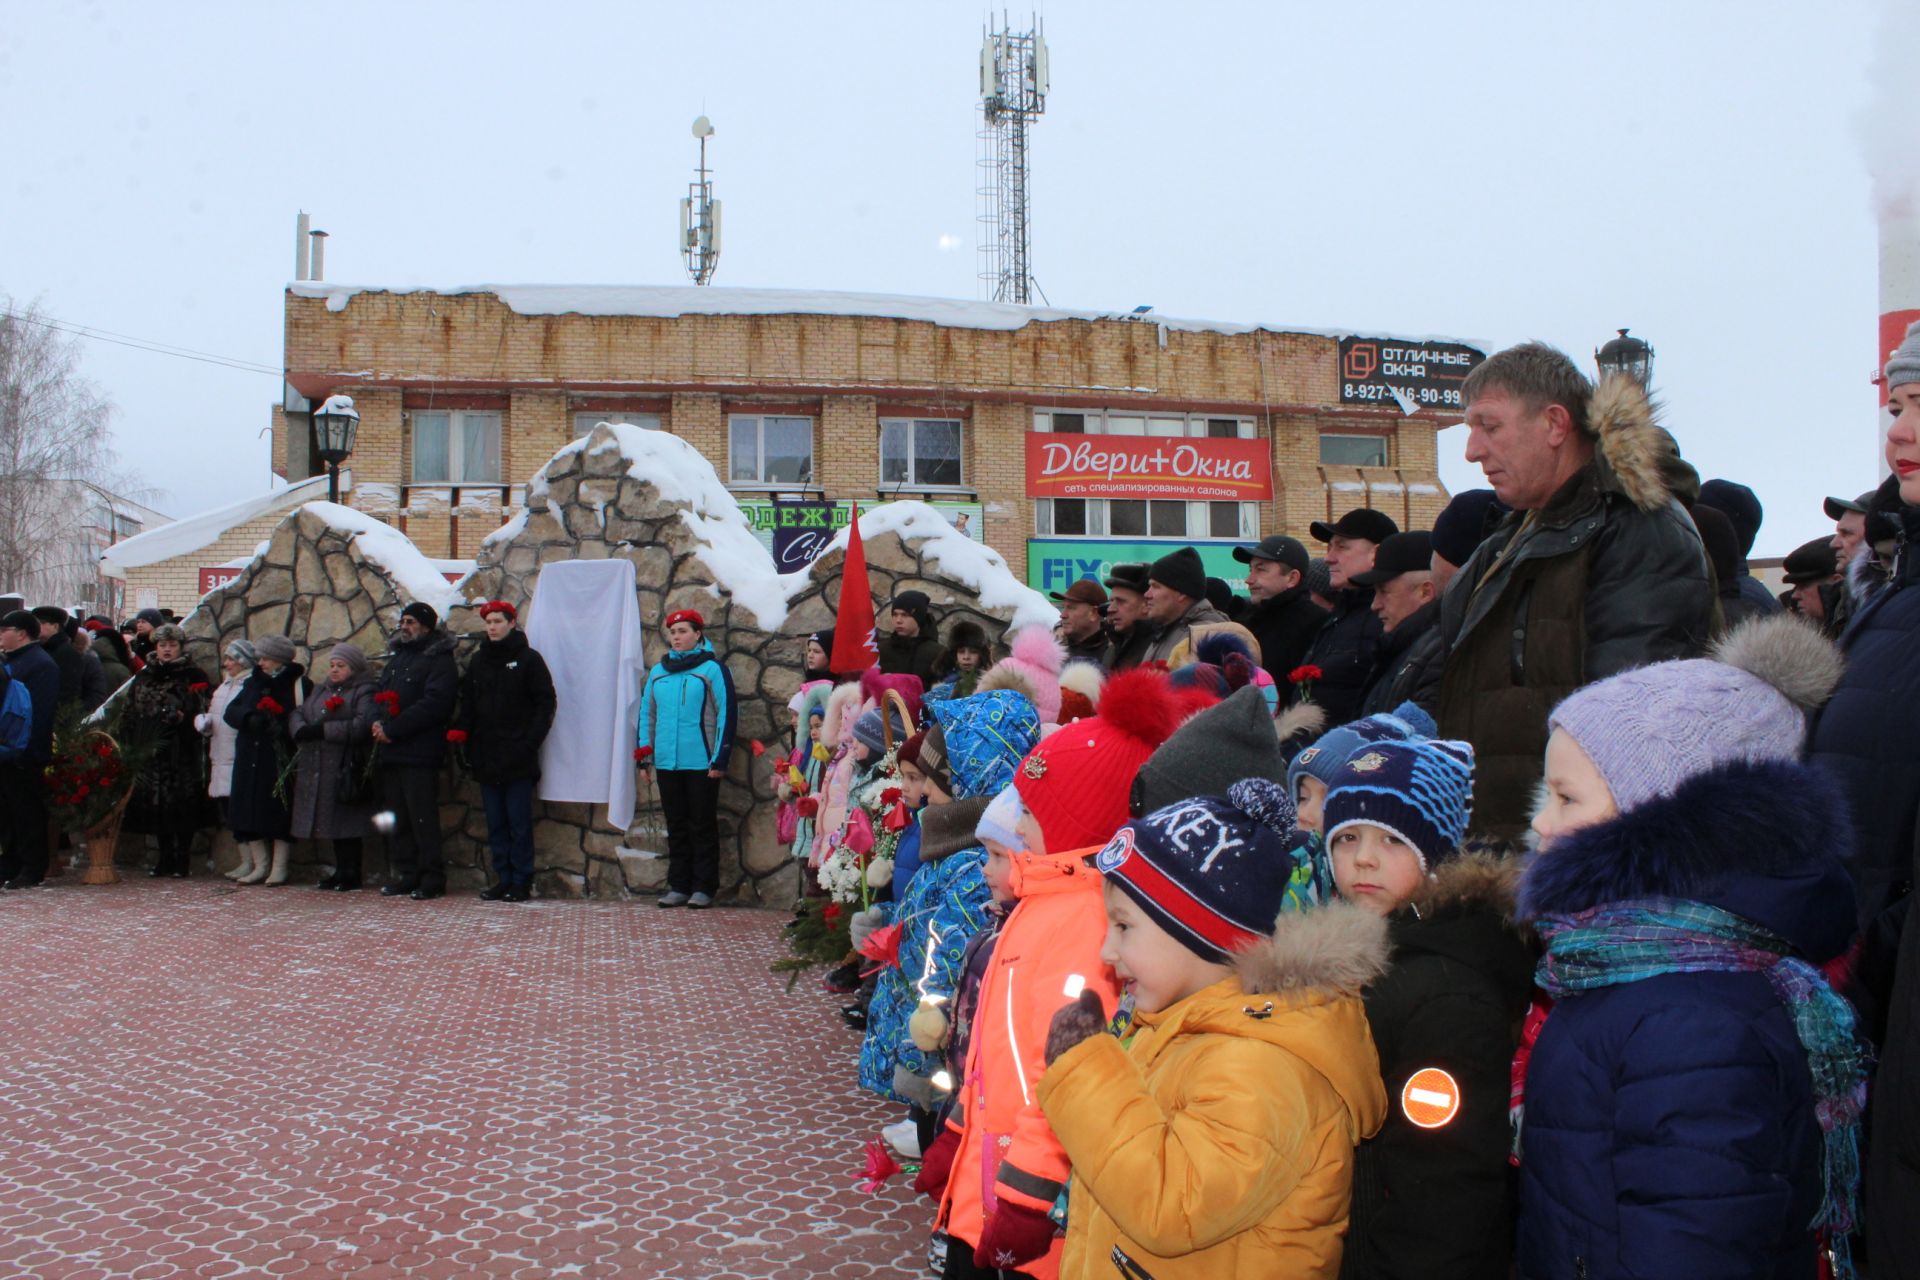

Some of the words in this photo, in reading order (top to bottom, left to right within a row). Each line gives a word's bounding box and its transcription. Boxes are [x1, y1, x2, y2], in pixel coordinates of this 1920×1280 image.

[1382, 348, 1471, 366] ОТЛИЧНЫЕ
[1382, 362, 1426, 378] ОКНА
[1041, 441, 1252, 481] Двери+Окна
[1064, 484, 1087, 493] сеть
[1089, 482, 1195, 494] специализированных
[1197, 486, 1238, 497] салонов
